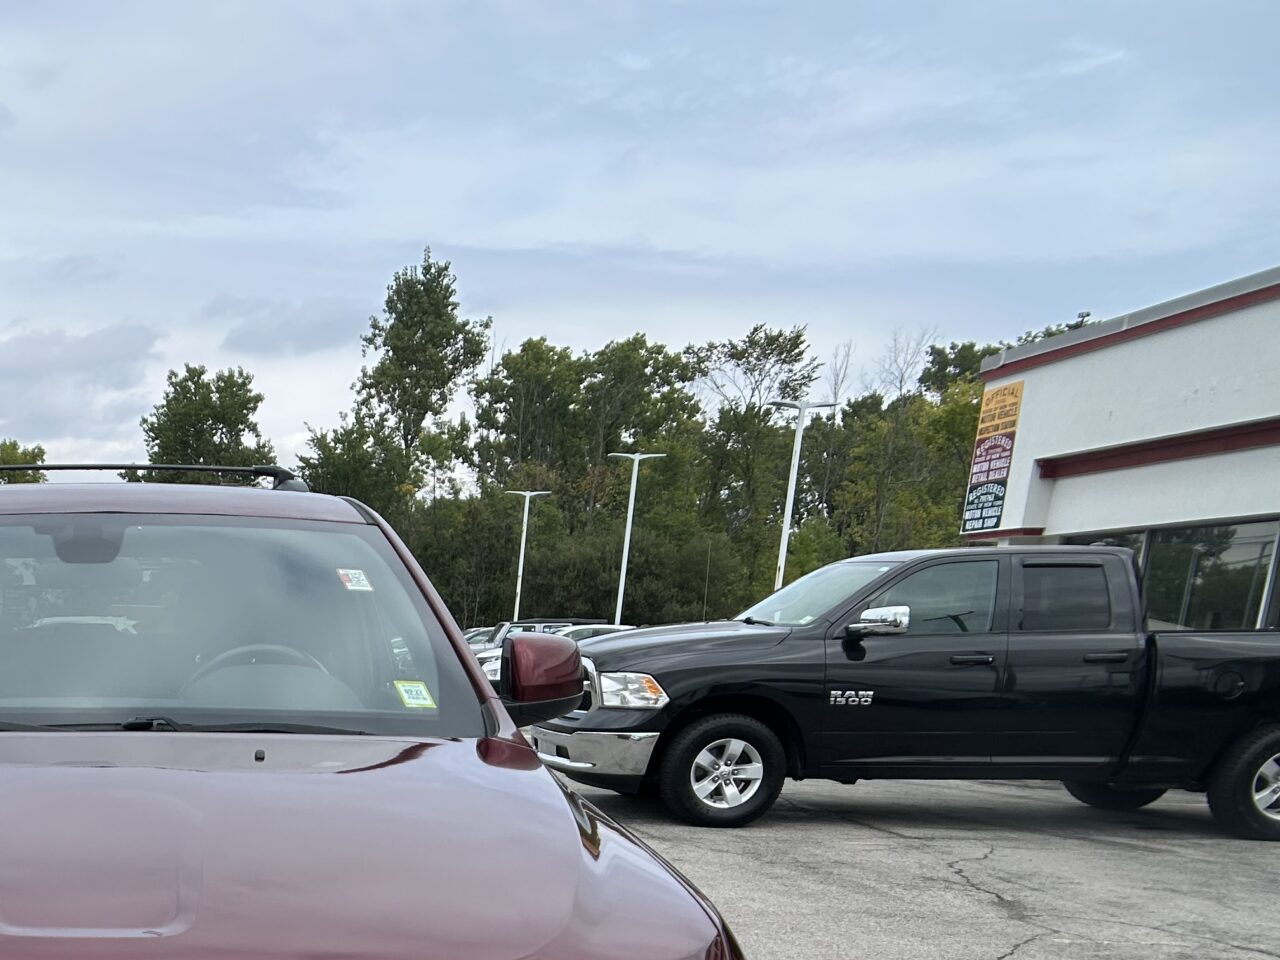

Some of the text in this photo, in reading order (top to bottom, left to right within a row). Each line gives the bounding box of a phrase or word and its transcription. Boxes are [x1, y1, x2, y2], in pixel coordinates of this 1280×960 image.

[985, 387, 1020, 407] OFFICIAL
[976, 435, 1012, 457] REGISTERED
[968, 483, 1005, 502] REGISTERED
[981, 505, 1002, 518] VEHICLE
[964, 516, 998, 530] REPAIR SHOP
[829, 697, 873, 705] 1500
[830, 690, 874, 698] RAM
